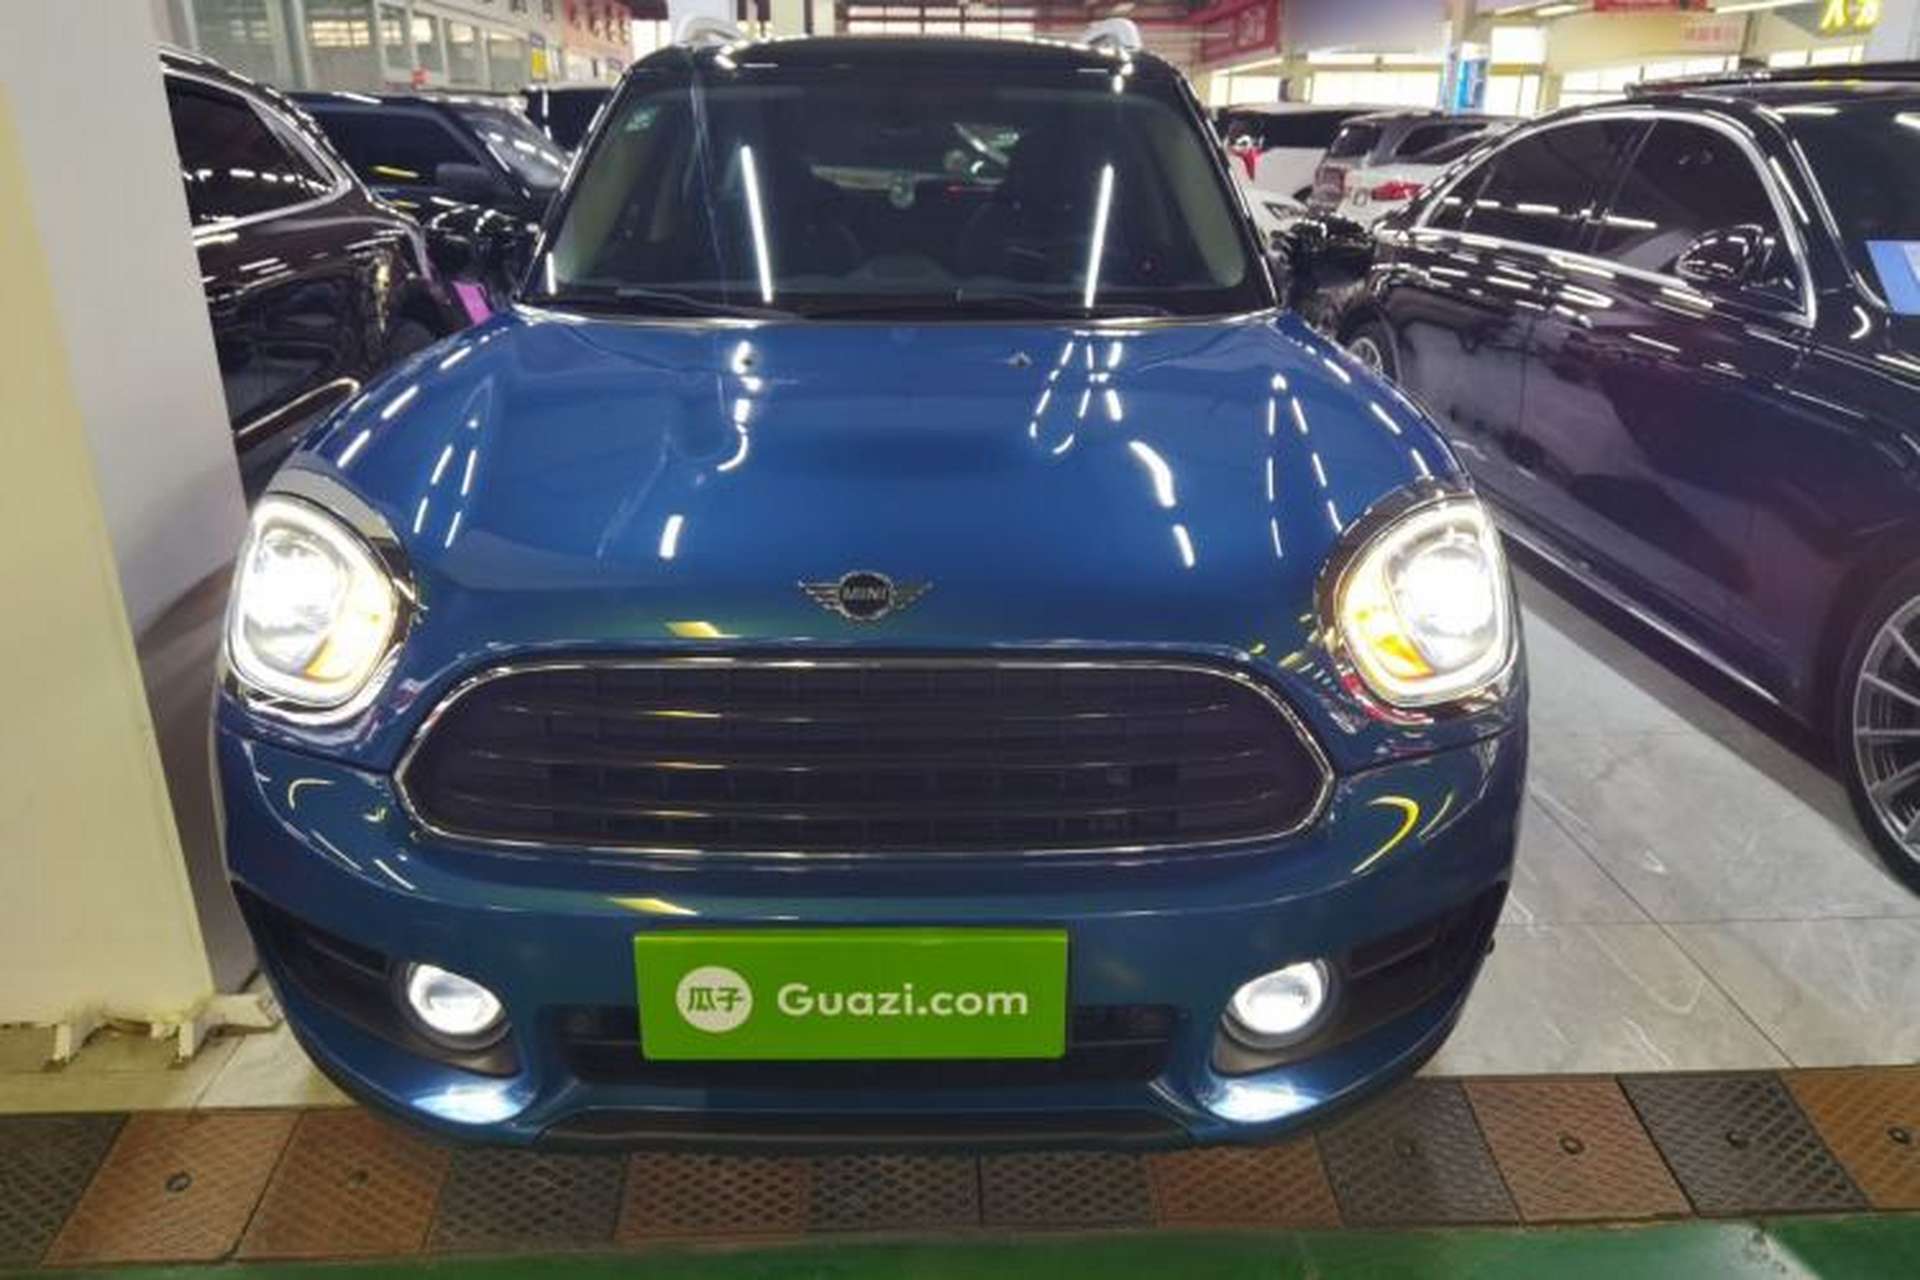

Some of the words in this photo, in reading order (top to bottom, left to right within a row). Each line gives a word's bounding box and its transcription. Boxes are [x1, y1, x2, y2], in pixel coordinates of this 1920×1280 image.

[842, 586, 887, 600] MINI
[687, 986, 745, 1013] 瓜子
[776, 982, 1030, 1017] Guazi.com
